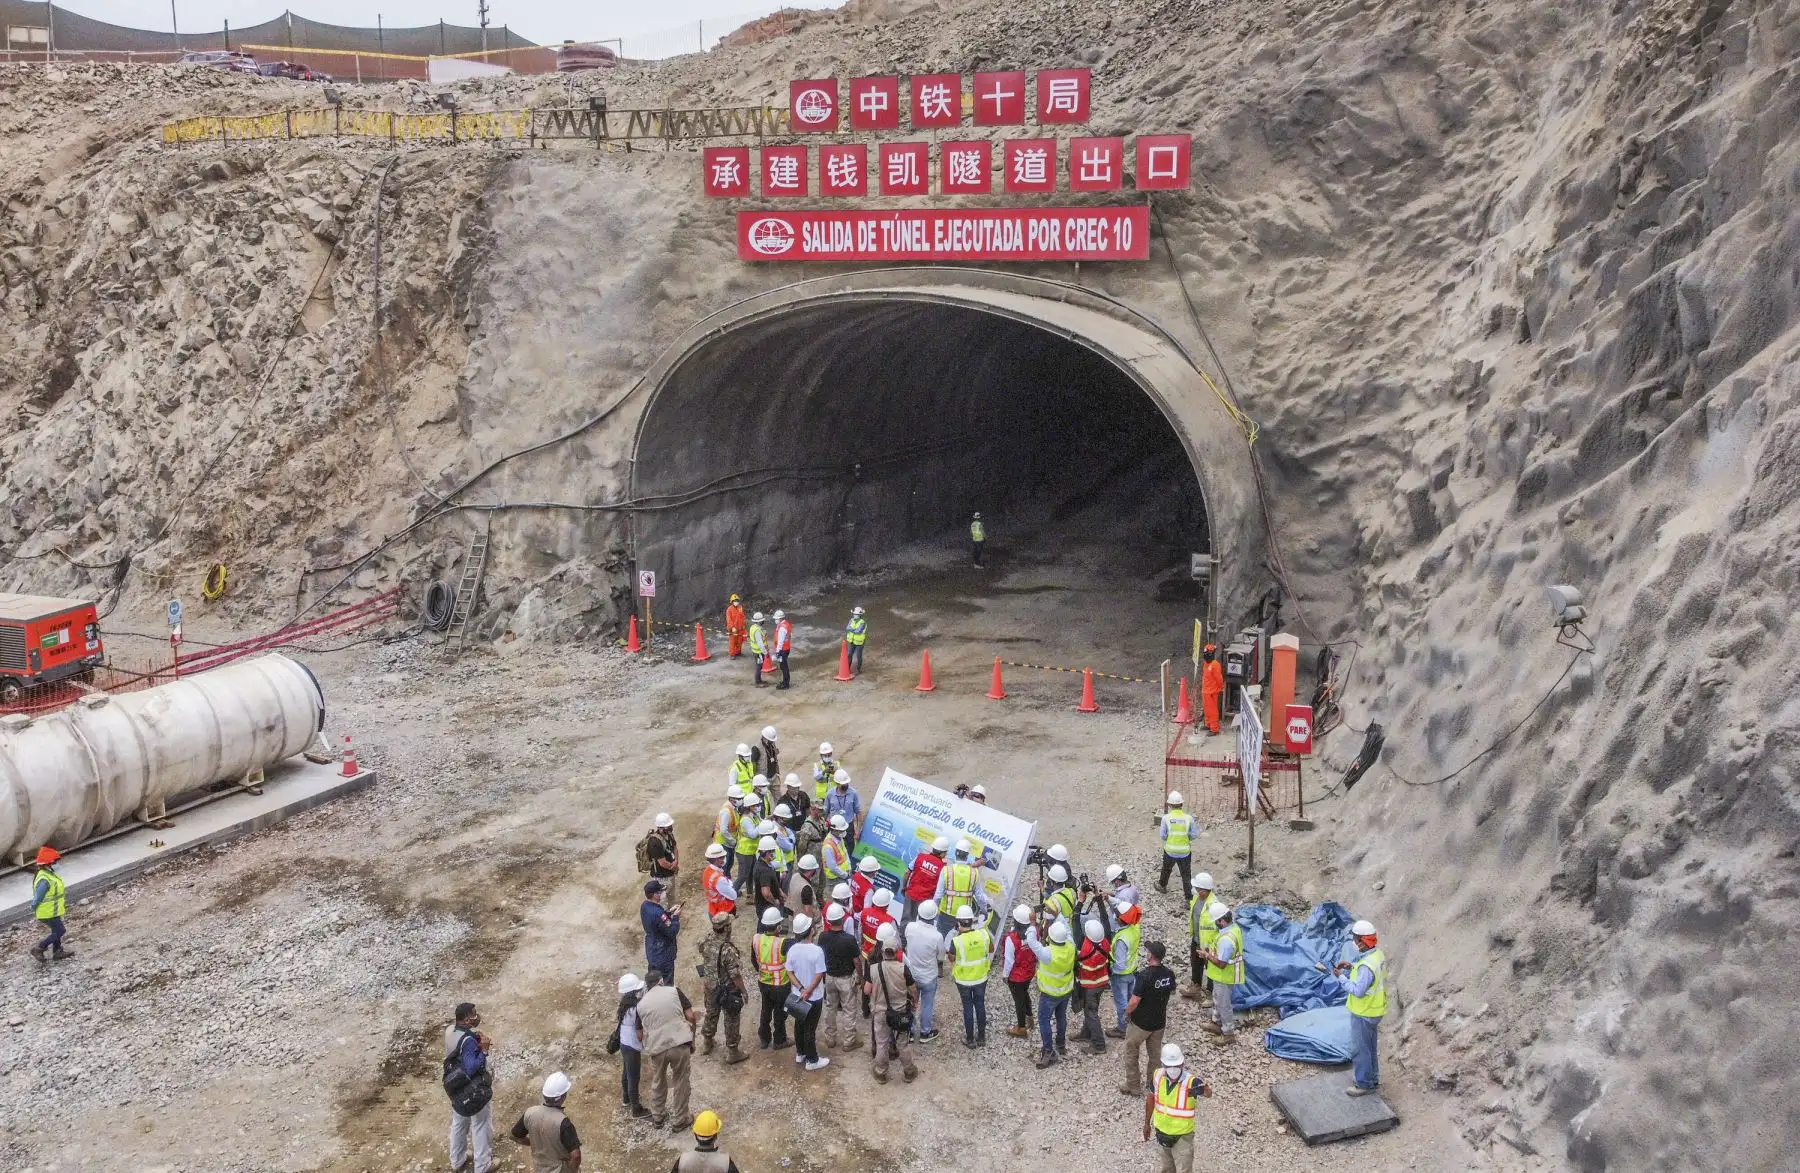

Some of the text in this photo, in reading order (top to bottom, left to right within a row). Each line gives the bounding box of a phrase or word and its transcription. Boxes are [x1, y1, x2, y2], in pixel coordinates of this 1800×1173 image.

[860, 79, 1079, 121] 中铁十局
[712, 146, 1178, 189] 承建钱凯隧道出口
[803, 214, 1131, 252] SALIDA DE TÚNEL EJECUTADA POR CREC 10
[1290, 726, 1307, 735] PARE
[889, 777, 952, 809] Terminal Portuario
[883, 790, 951, 823] multipropósito
[952, 817, 965, 829] de
[967, 822, 1013, 851] Chancay
[922, 860, 938, 873] MTC
[866, 915, 879, 924] MTC
